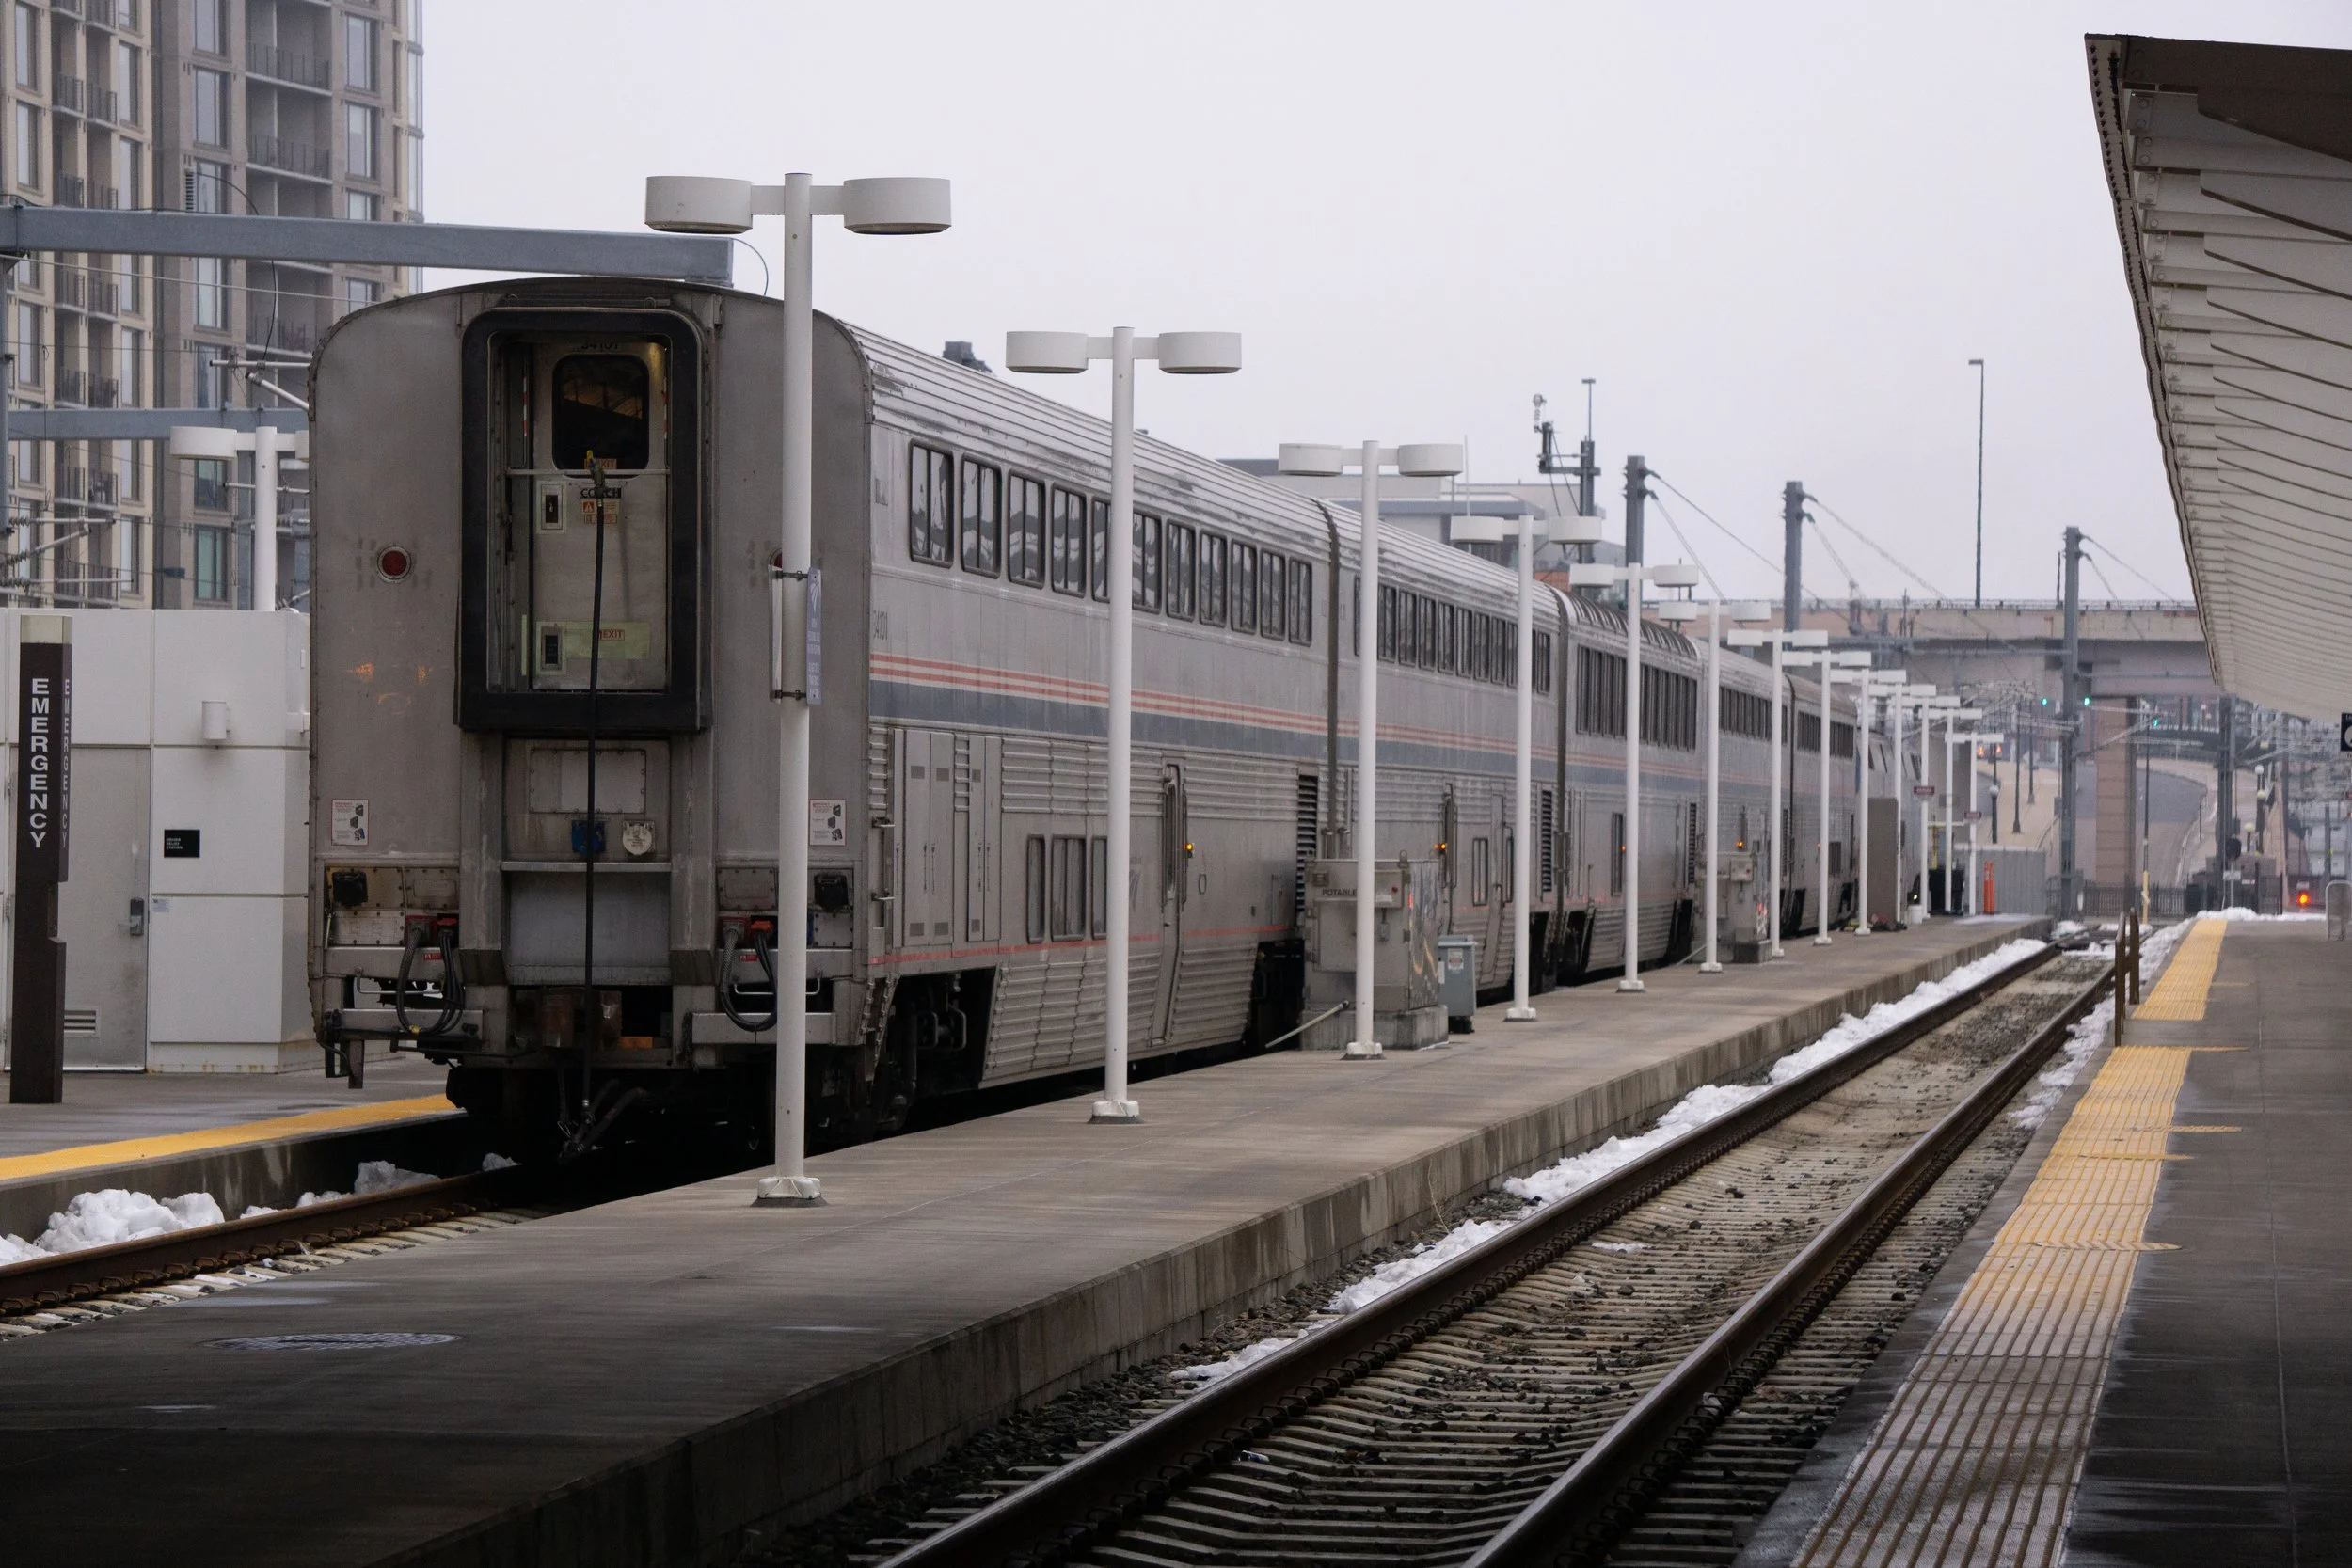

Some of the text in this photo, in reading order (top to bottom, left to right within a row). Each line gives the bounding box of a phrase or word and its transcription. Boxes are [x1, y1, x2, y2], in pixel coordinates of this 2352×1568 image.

[580, 488, 621, 499] COCH
[603, 629, 622, 639] EXIT
[29, 678, 49, 847] EMERGENCY
[60, 679, 70, 847] EMERGENCY
